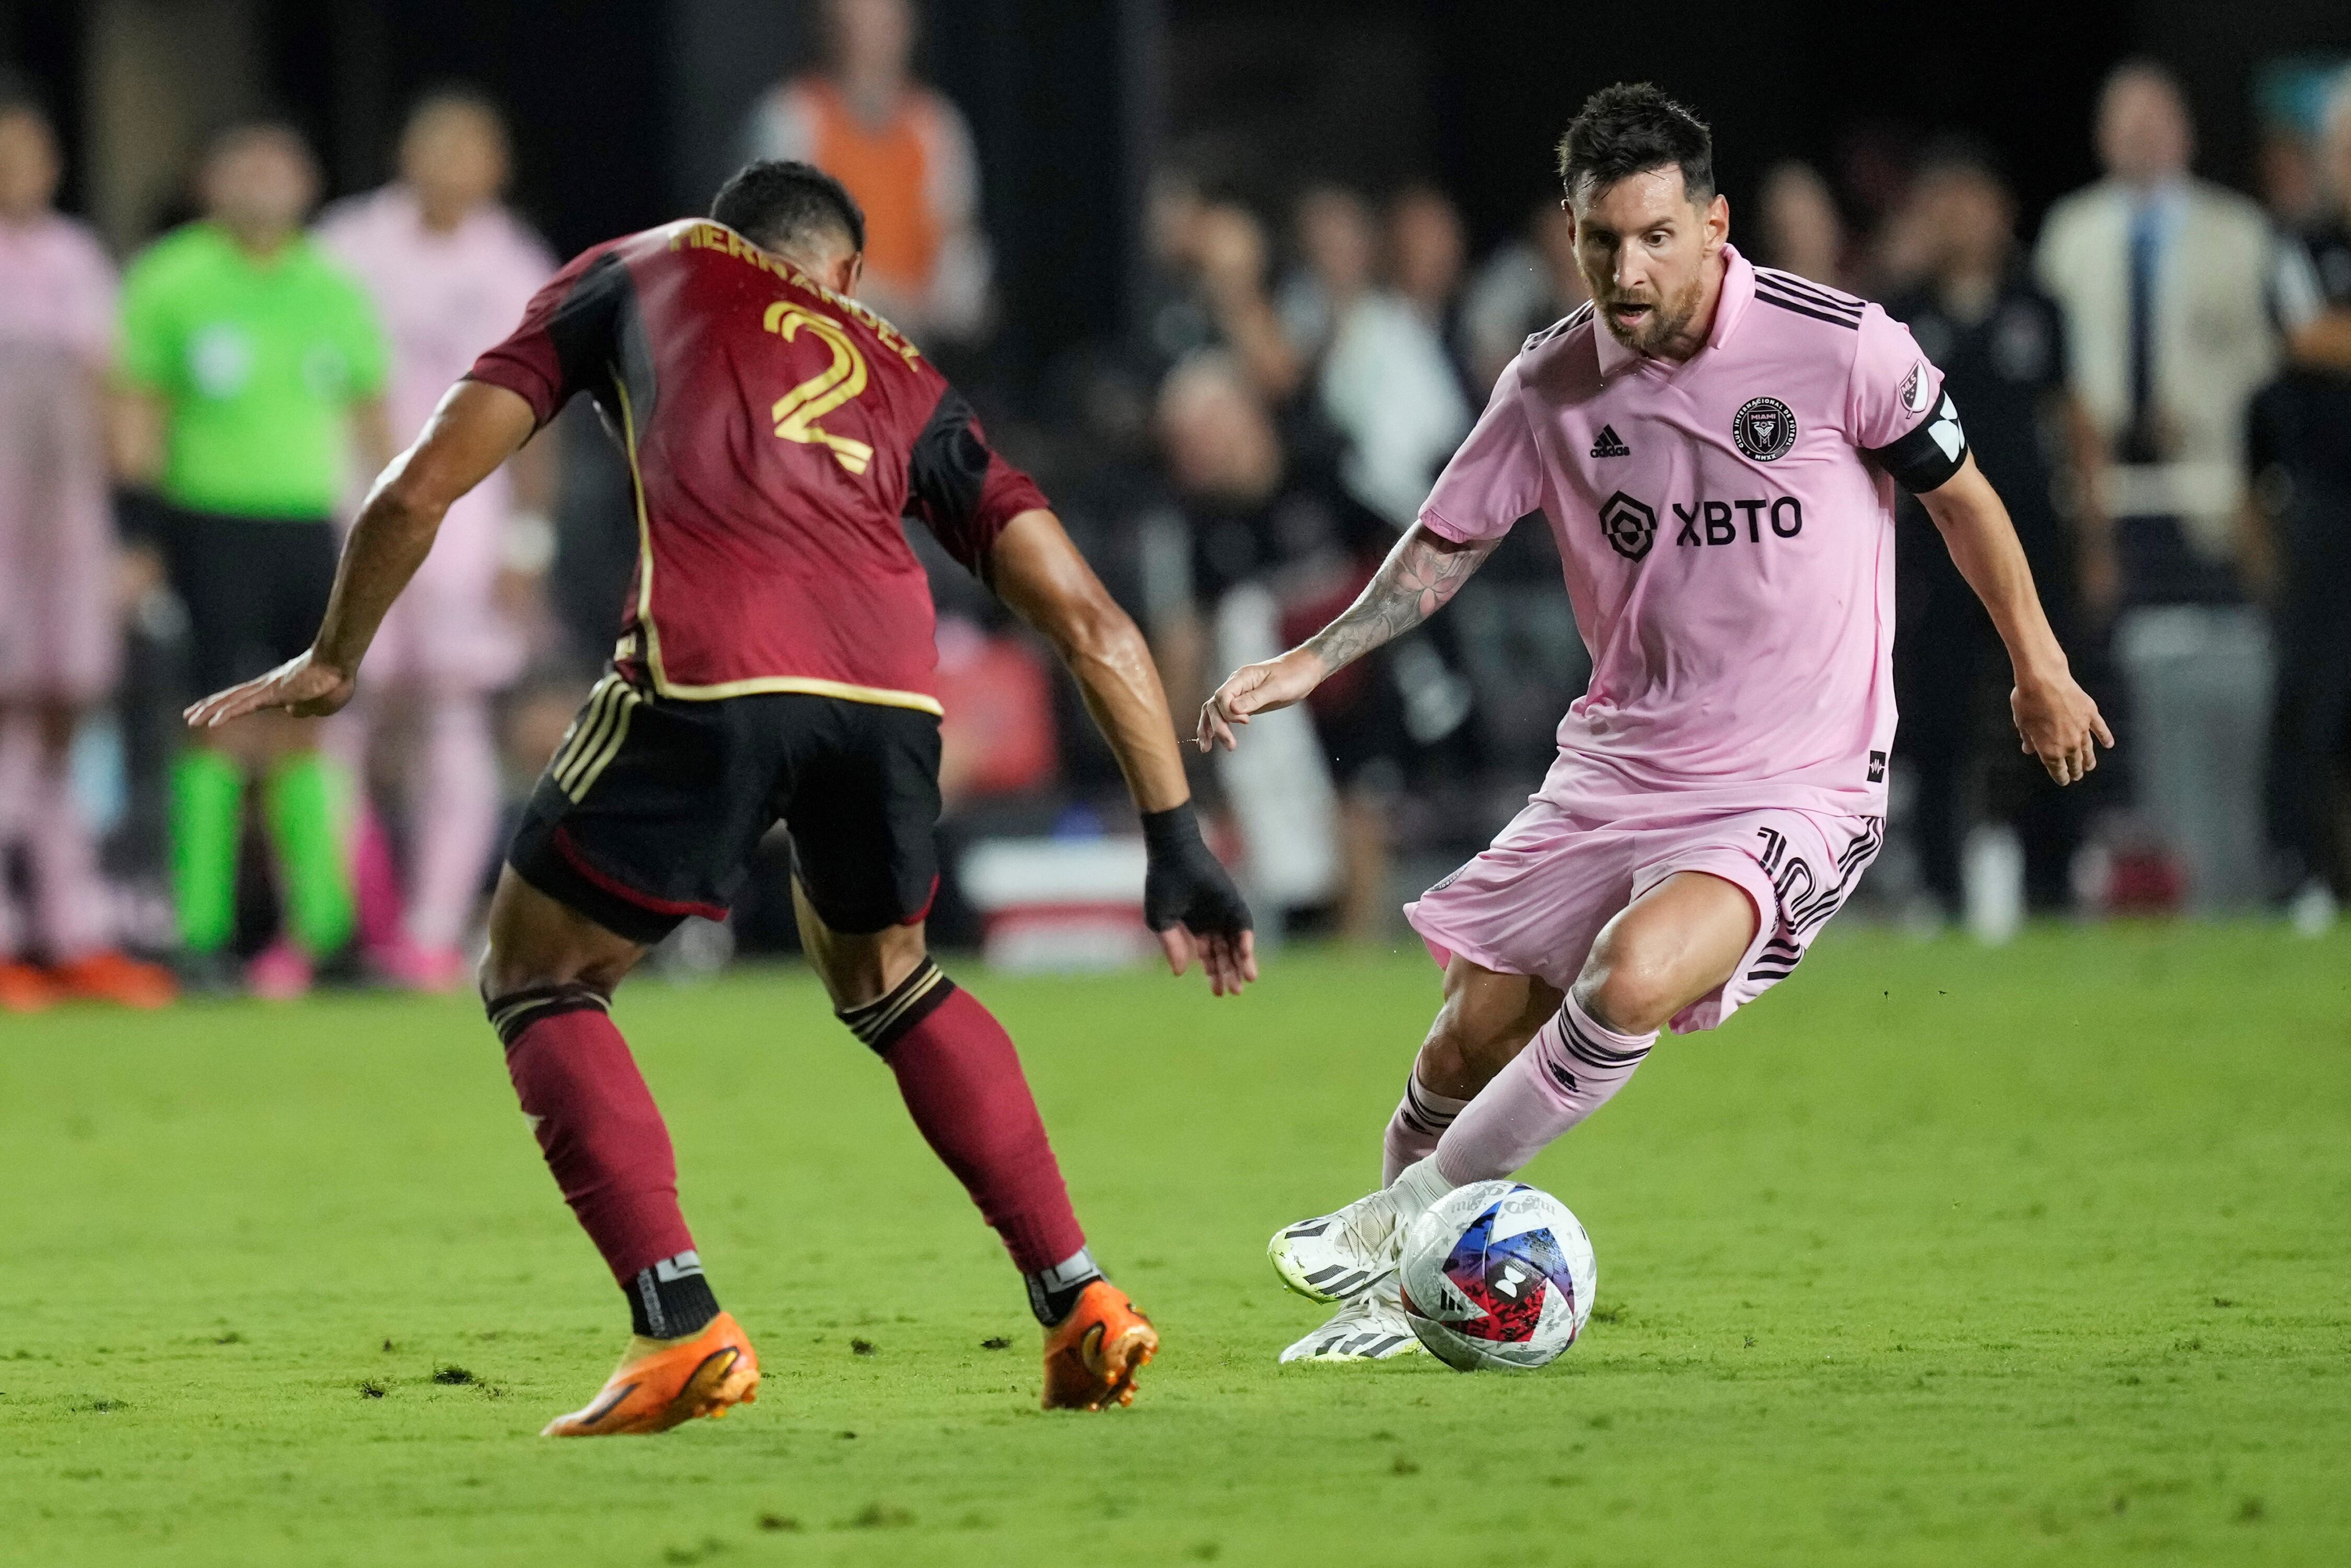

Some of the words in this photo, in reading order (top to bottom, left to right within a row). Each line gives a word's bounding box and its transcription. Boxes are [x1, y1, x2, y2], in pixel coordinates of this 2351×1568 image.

[763, 300, 874, 475] 2
[1901, 374, 1917, 394] MLS
[1734, 399, 1783, 427] INTERNACIONAL
[1783, 409, 1792, 419] DE
[1734, 430, 1744, 448] CLUB
[1590, 445, 1631, 458] adidas
[1672, 496, 1802, 547] XBTO
[1756, 826, 1816, 911] 10
